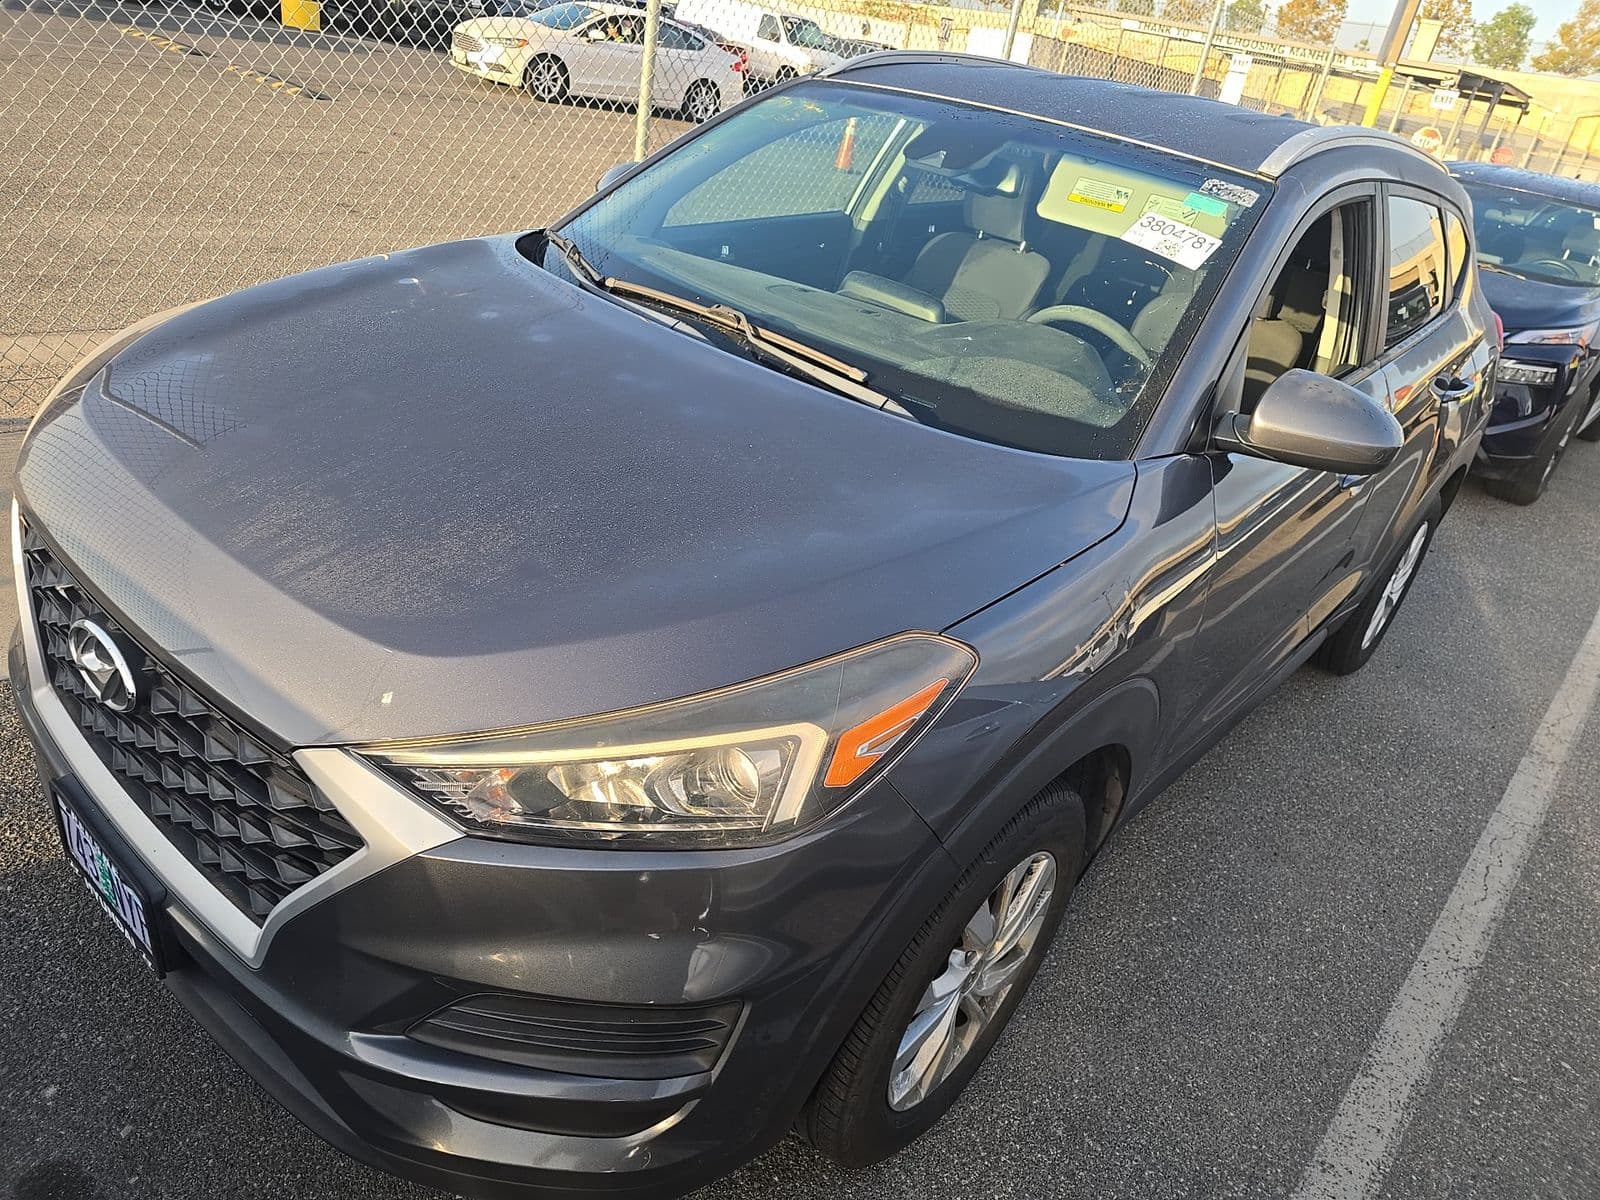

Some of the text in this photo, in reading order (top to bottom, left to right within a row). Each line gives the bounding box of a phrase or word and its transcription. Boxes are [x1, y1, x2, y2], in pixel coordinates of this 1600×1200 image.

[1227, 37, 1286, 55] CHOOSING
[1434, 94, 1454, 105] EXIT
[1139, 215, 1216, 254] 3804781
